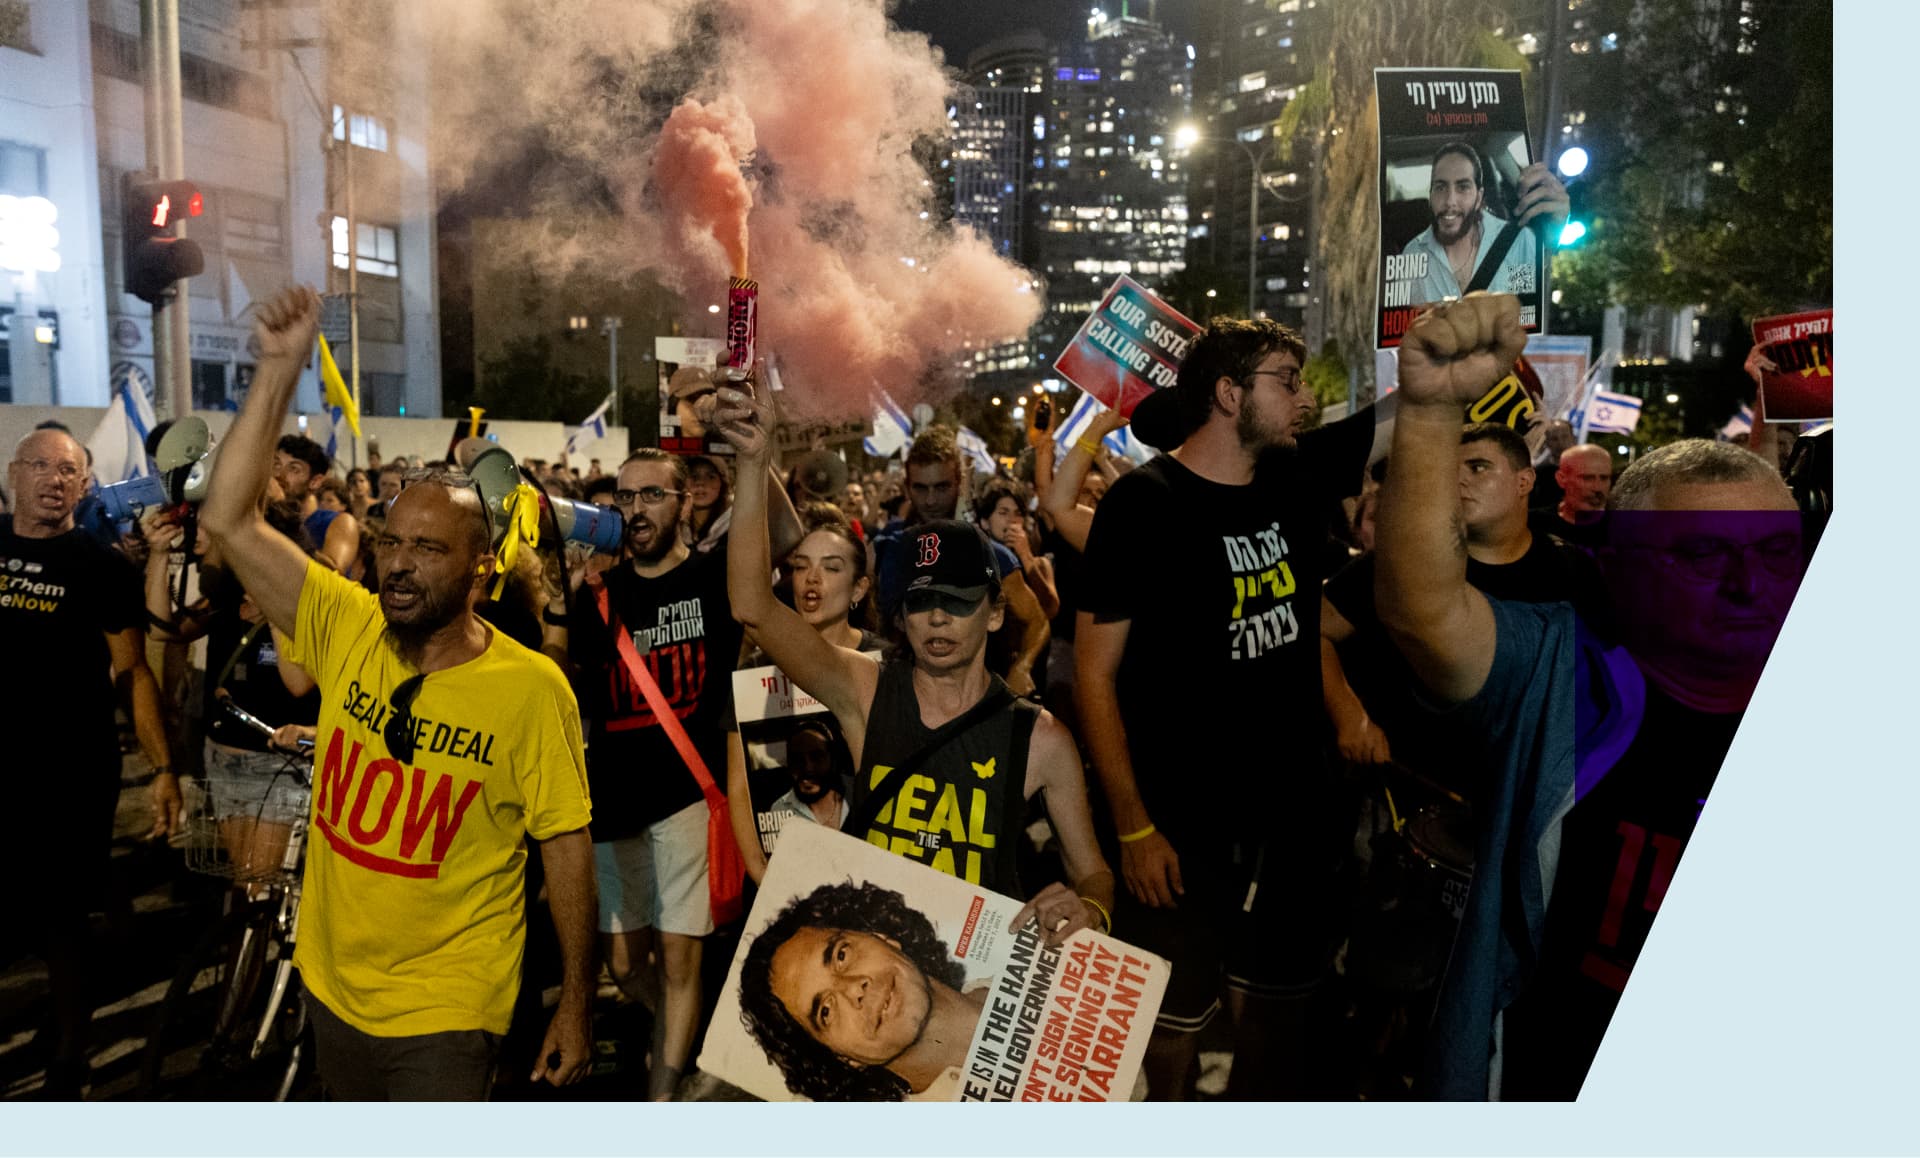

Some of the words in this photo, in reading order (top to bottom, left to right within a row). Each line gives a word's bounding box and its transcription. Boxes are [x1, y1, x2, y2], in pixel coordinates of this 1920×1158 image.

[1406, 82, 1426, 105] חי
[1427, 82, 1466, 110] עדיין
[1468, 82, 1500, 109] מתן
[1385, 253, 1428, 280] BRING
[1384, 281, 1411, 308] HIM
[1109, 295, 1147, 329] OUR
[1143, 321, 1189, 360] SISTE
[1519, 313, 1536, 326] RUM
[1087, 318, 1151, 372] CALLING
[915, 532, 941, 568] B
[1222, 535, 1262, 572] הם
[0, 593, 59, 613] eNow
[1231, 560, 1296, 619] עדיין
[658, 597, 702, 625] מחזירים
[671, 616, 705, 642] אותם
[761, 676, 778, 694] חי
[343, 681, 382, 734] SEAL
[429, 722, 495, 766] DEAL
[317, 726, 482, 863] NOW
[918, 831, 941, 850] THE
[1060, 941, 1095, 993] DEAL
[1006, 940, 1065, 1066] GOVERNMEN
[1055, 996, 1076, 1013] A
[1055, 986, 1107, 1087] SIGNING
[1088, 944, 1119, 986] MY
[982, 997, 1016, 1045] THE
[1037, 1010, 1069, 1061] SIGN
[976, 1046, 1000, 1066] IN
[970, 1062, 994, 1082] IS
